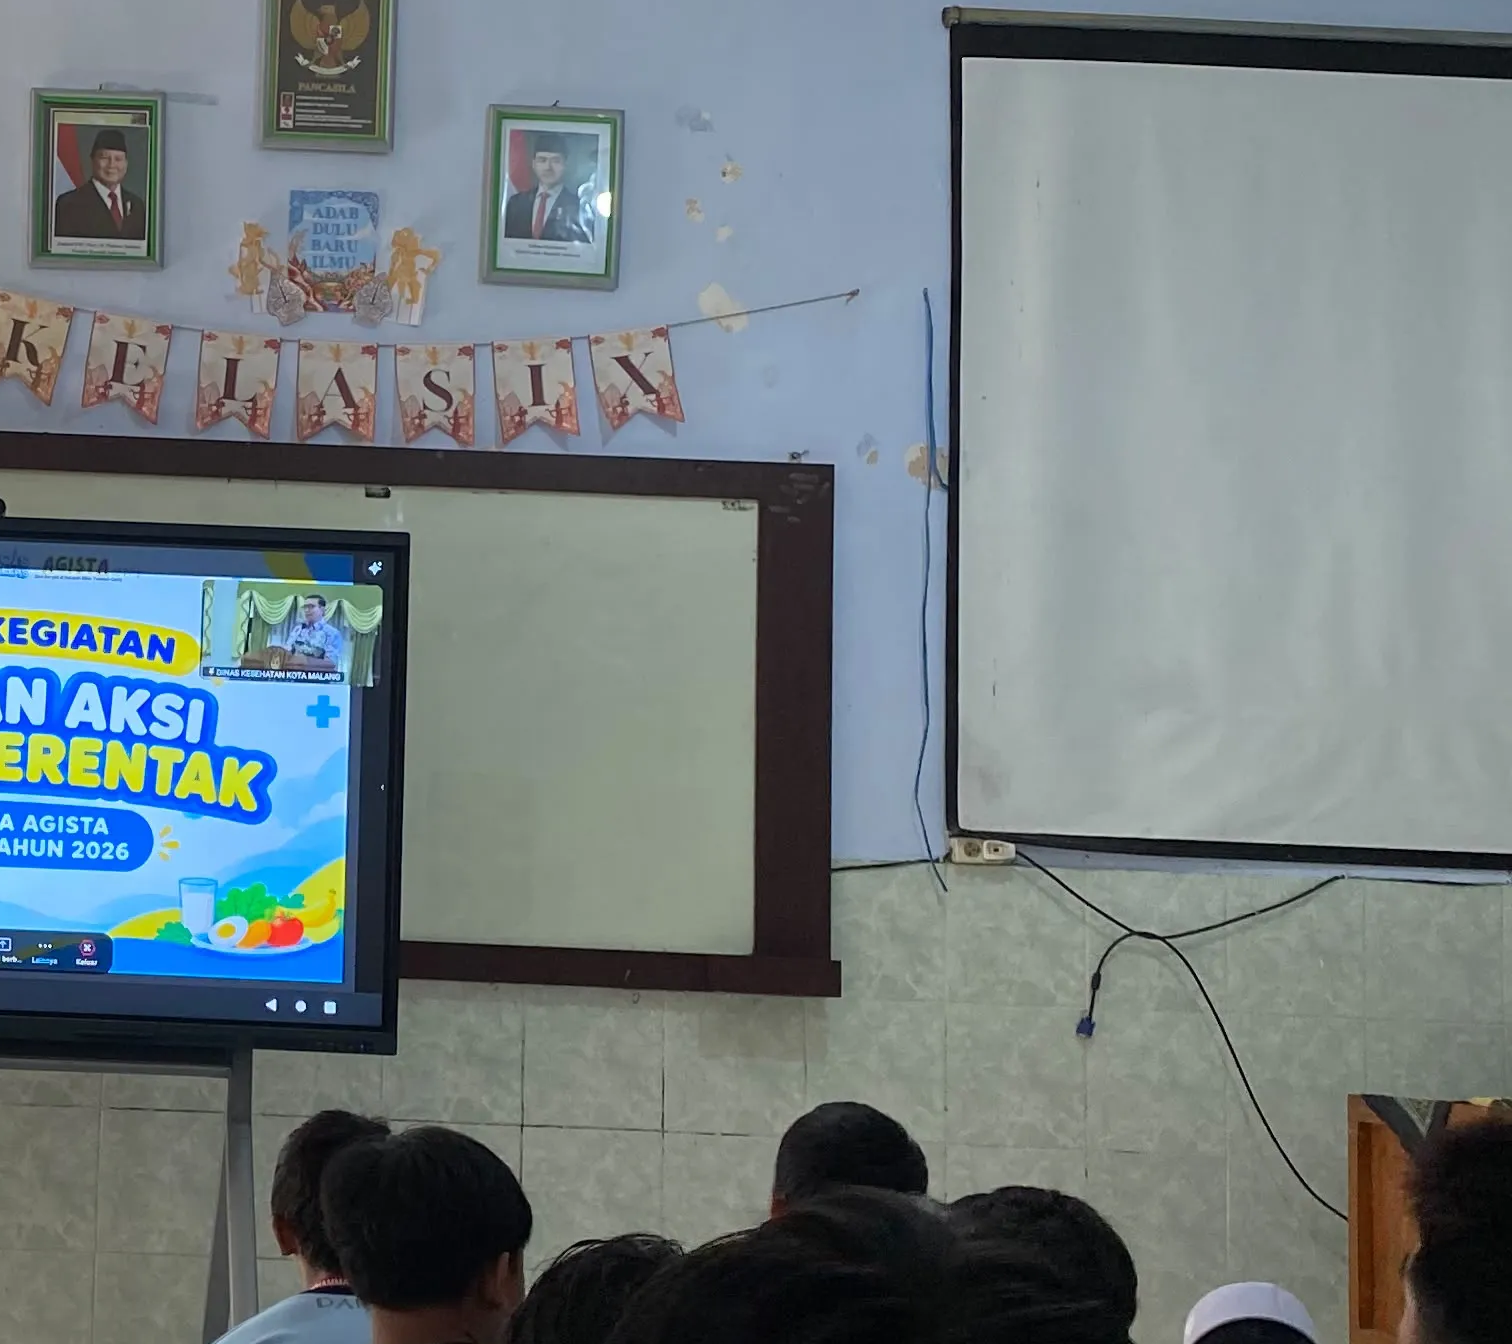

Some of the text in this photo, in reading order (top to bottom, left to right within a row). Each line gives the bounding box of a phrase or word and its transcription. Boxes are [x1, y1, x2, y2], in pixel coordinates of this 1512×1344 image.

[298, 82, 356, 93] PANCASILA
[312, 207, 359, 219] ADAB
[312, 223, 358, 236] DULU
[311, 240, 358, 253] BARU
[312, 256, 356, 269] ILMU
[43, 555, 108, 574] AGISTA
[287, 671, 307, 681] KOTA
[308, 672, 341, 681] MALANG
[64, 682, 207, 743] AKSI
[22, 814, 109, 836] AGISTA
[71, 839, 130, 862] 2026
